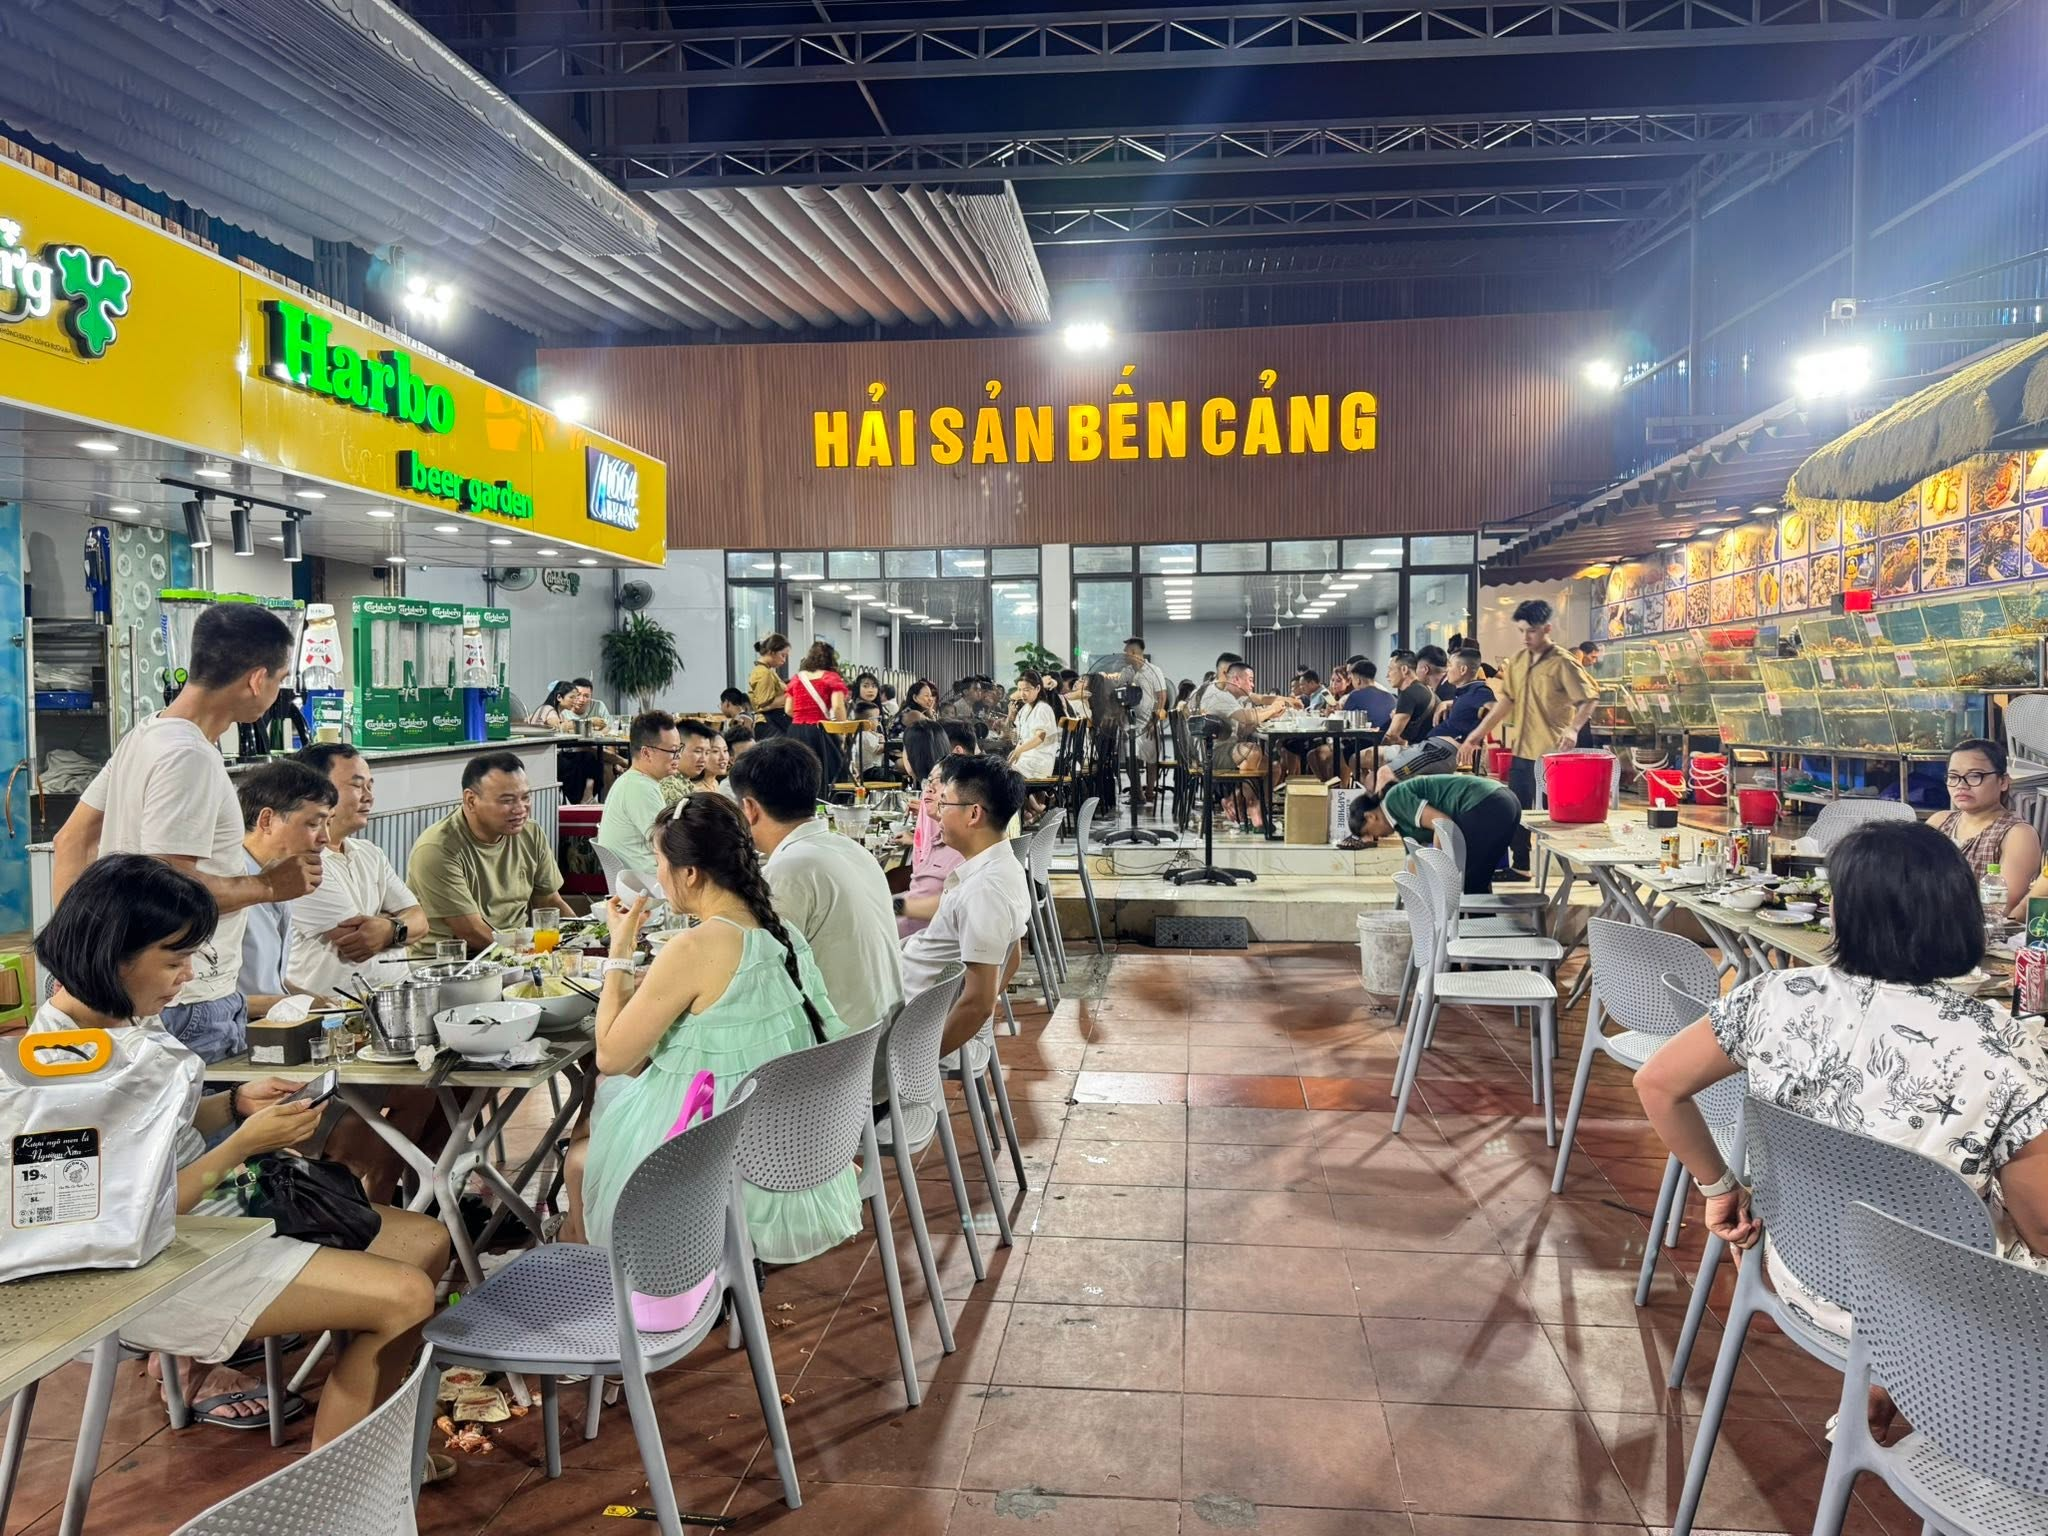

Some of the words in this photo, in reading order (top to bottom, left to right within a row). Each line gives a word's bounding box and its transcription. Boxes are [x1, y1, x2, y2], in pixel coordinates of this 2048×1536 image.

[277, 299, 455, 434] Harbo
[814, 382, 916, 468] HẢI
[930, 379, 1054, 466] SẢN
[1068, 364, 1187, 462] BẾN
[1201, 369, 1378, 457] CẢNG
[412, 449, 463, 500] beer
[469, 479, 533, 520] garden
[363, 601, 397, 614] Carlsberg
[398, 604, 428, 616] Carlsberg
[431, 607, 462, 619] Carlsberg
[483, 612, 509, 623] Carlsberg
[398, 717, 428, 729] Carlsberg
[432, 716, 462, 727] Carlsberg
[484, 713, 509, 724] Carlsberg
[364, 719, 397, 731] Carlsberg
